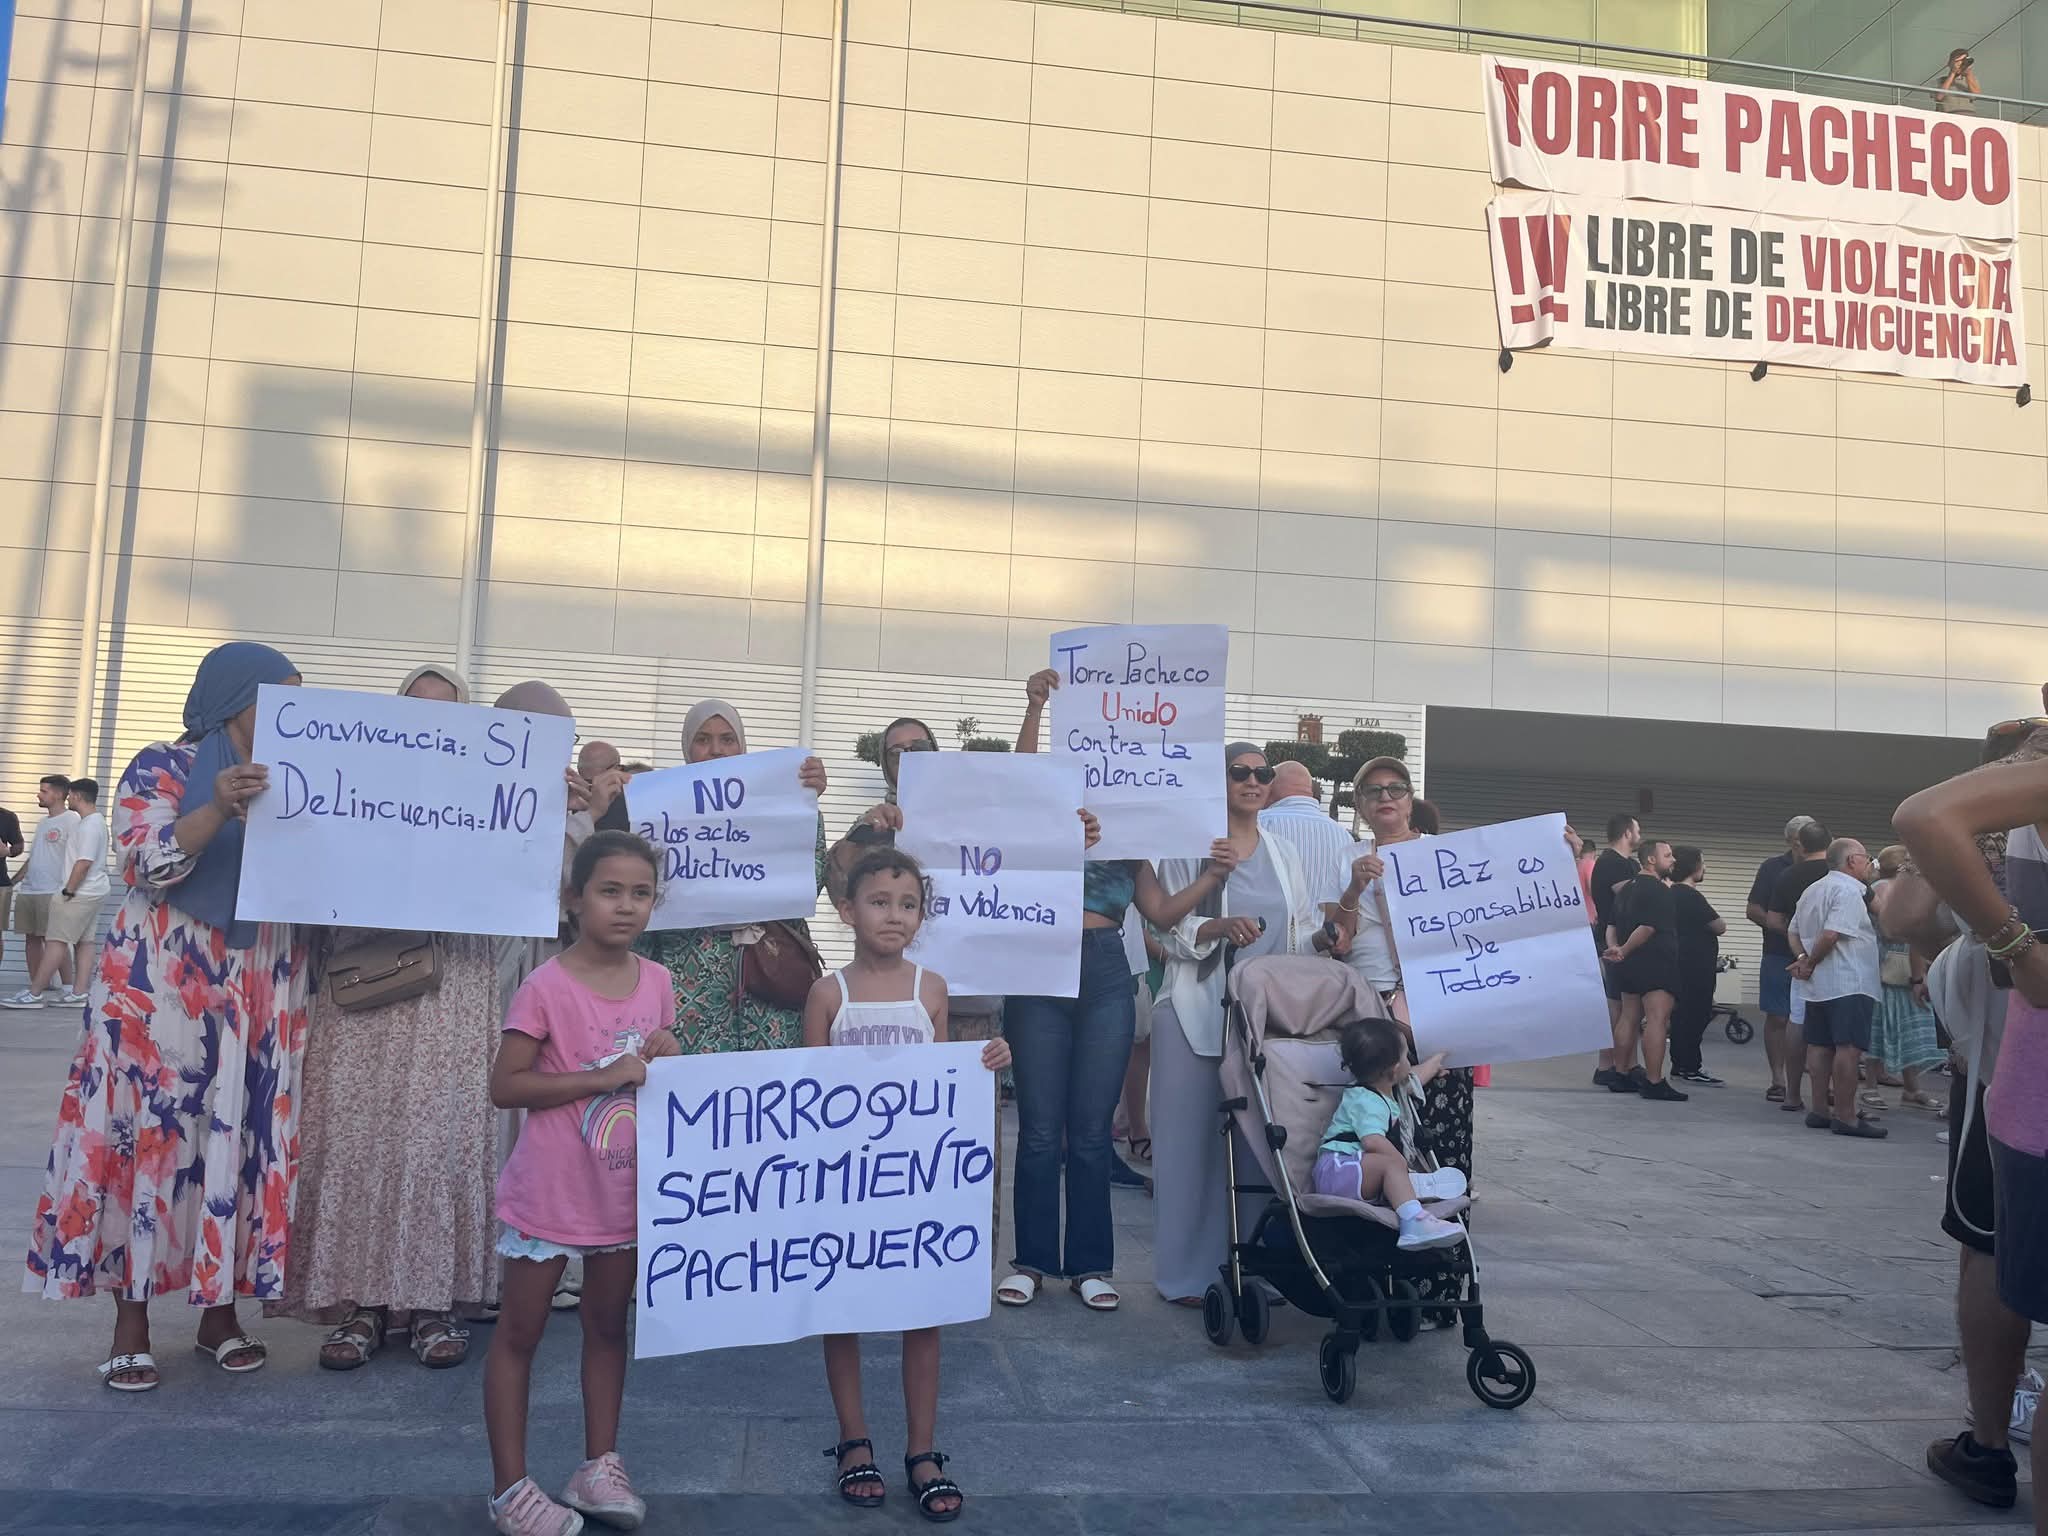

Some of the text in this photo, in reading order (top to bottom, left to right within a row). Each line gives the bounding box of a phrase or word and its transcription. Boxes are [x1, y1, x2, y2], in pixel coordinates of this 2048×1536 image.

[1495, 65, 2011, 206] TORRE PACHECO
[1586, 215, 2013, 314] LIBRE DE VIOLENCIA
[1584, 279, 2018, 367] LIBRE DE DELINCUENCIA
[1057, 642, 1209, 686] Torre Pacheco
[1355, 717, 1380, 727] PLAZA
[489, 782, 538, 834] NO
[693, 777, 745, 814] NO
[639, 821, 658, 842] a
[960, 845, 1002, 876] NO
[1435, 849, 1493, 890] Paz
[1518, 857, 1545, 875] es
[1463, 933, 1500, 961] De
[646, 1220, 981, 1308] PACHEQUERO
